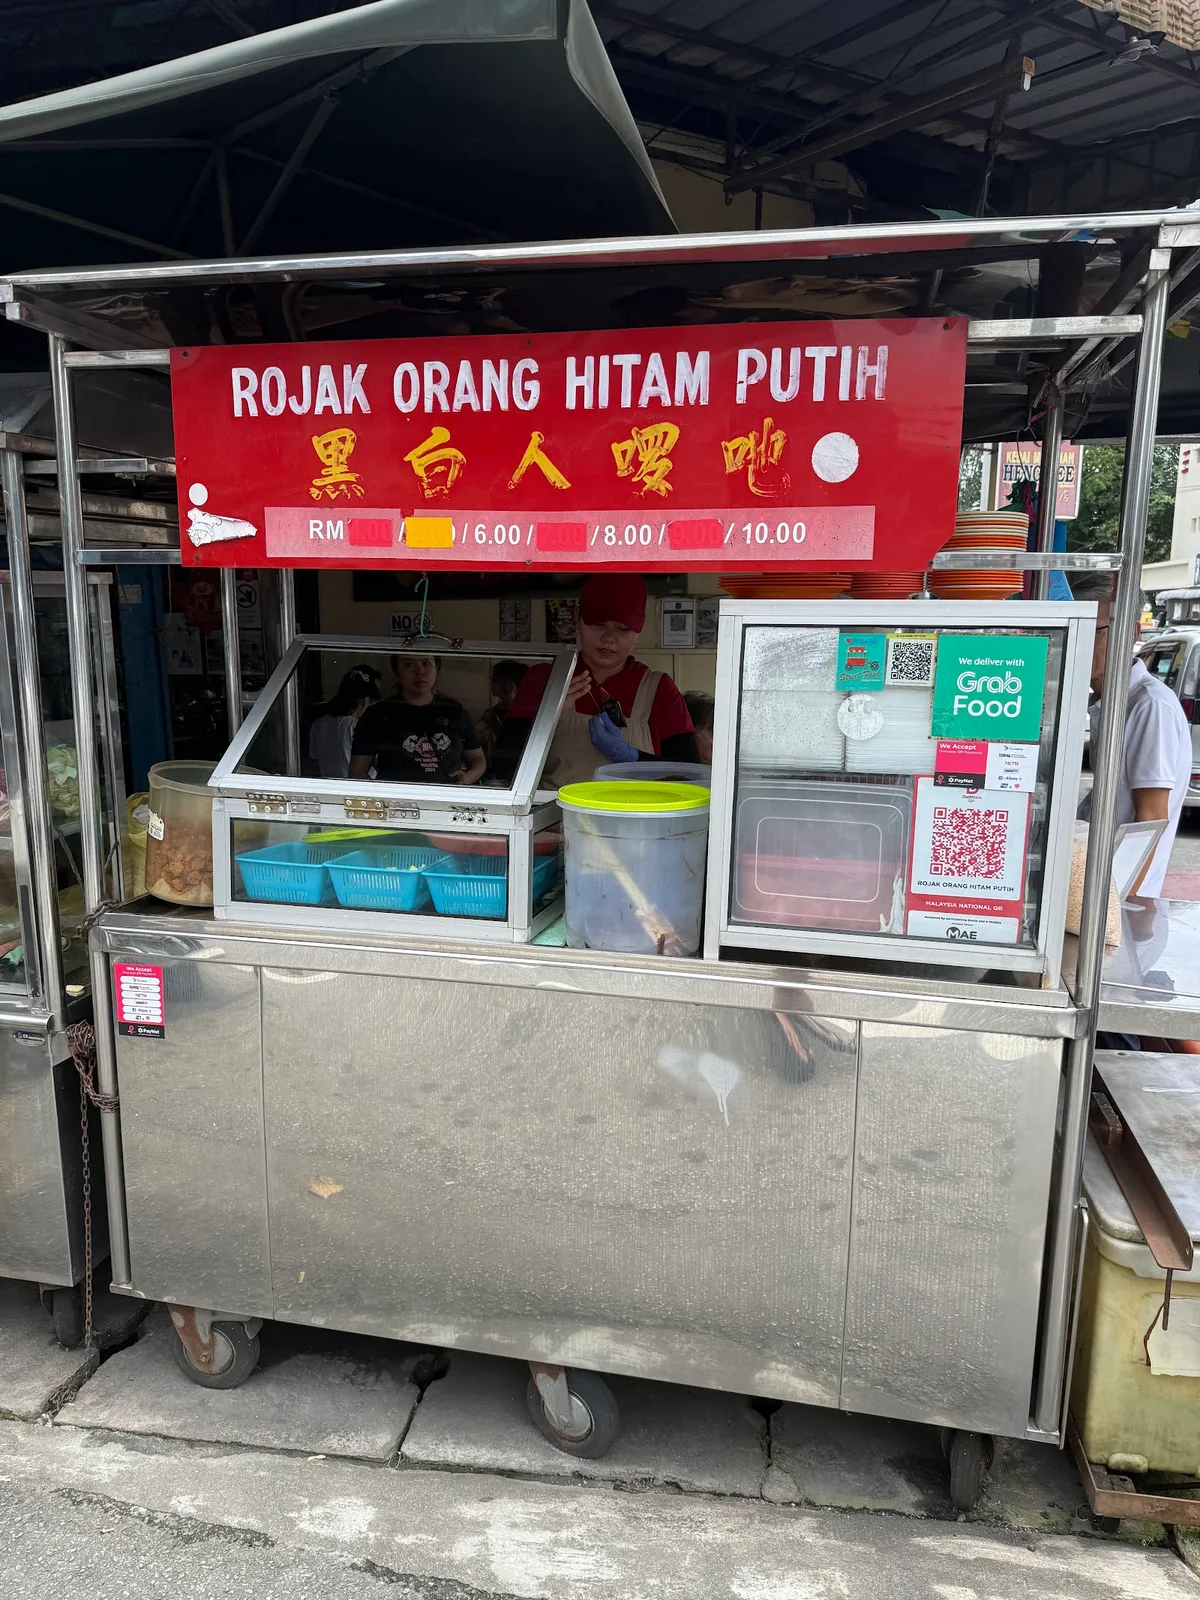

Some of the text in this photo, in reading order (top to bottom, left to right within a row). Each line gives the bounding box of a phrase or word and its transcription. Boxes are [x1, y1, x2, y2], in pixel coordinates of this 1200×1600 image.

[231, 345, 889, 418] ROJAK ORANG HITAM PUTIH
[309, 519, 345, 541] RM
[474, 523, 521, 546] 6.00
[603, 524, 652, 547] 8.00
[742, 521, 807, 545] 10.00
[391, 615, 412, 630] NO
[958, 657, 1025, 667] We deliver with
[956, 671, 1022, 694] Grab
[953, 694, 1022, 718] Food
[952, 743, 977, 751] Accept
[917, 880, 941, 888] ROJAK
[942, 882, 968, 890] ORANG
[925, 900, 957, 908] MALAYSIA
[958, 903, 992, 911] NATIONAL
[946, 926, 978, 940] MAE
